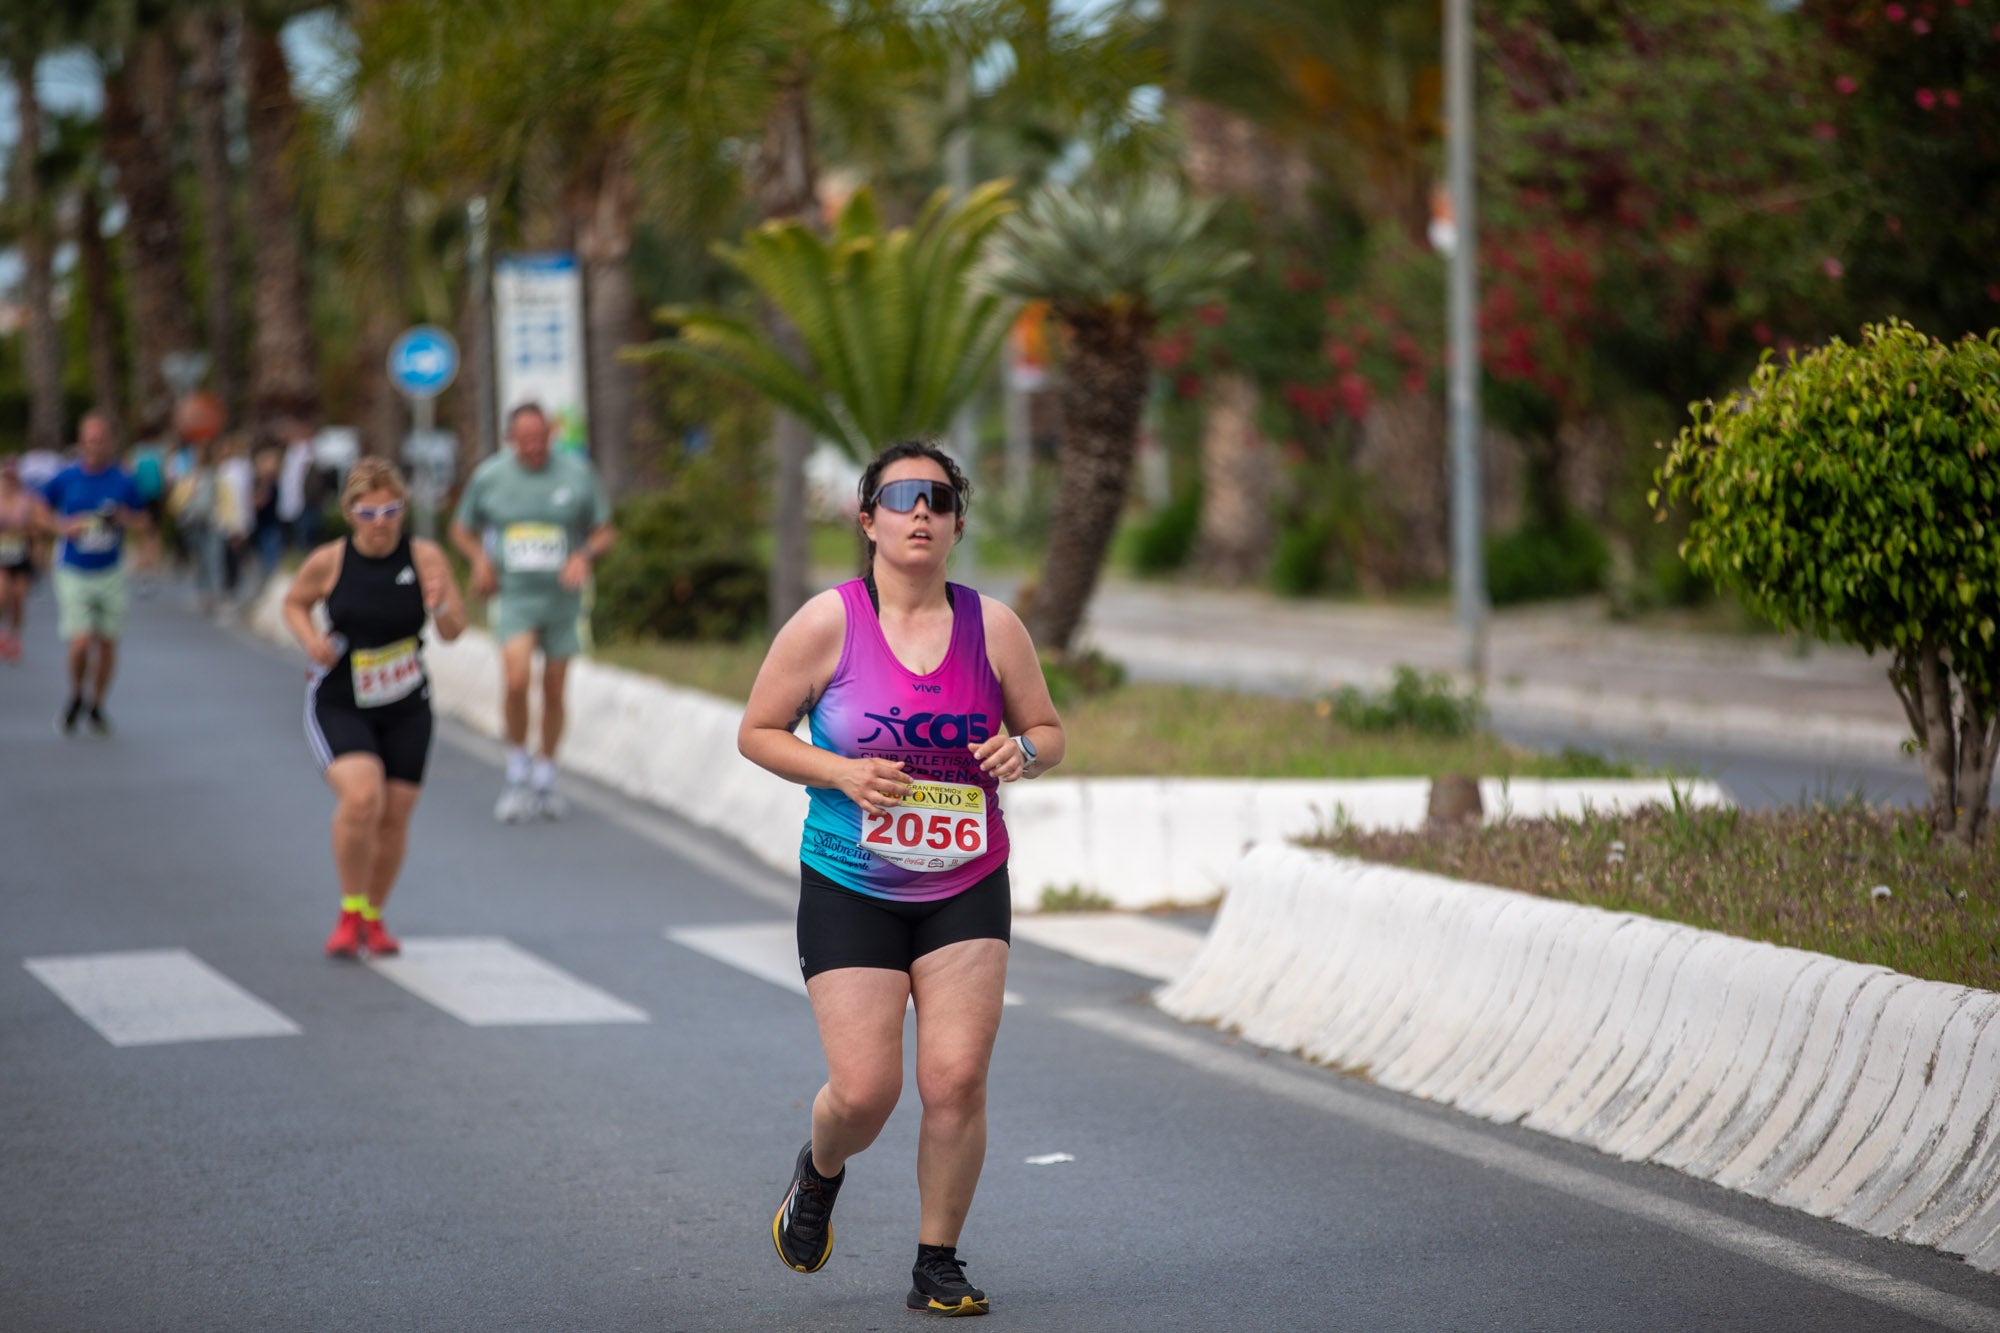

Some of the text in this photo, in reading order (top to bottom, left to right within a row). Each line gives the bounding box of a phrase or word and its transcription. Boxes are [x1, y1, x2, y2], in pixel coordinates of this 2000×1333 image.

[912, 683, 941, 694] vive
[905, 755, 979, 767] ATLETISM
[930, 785, 957, 794] PREMIO
[866, 811, 981, 852] 2056
